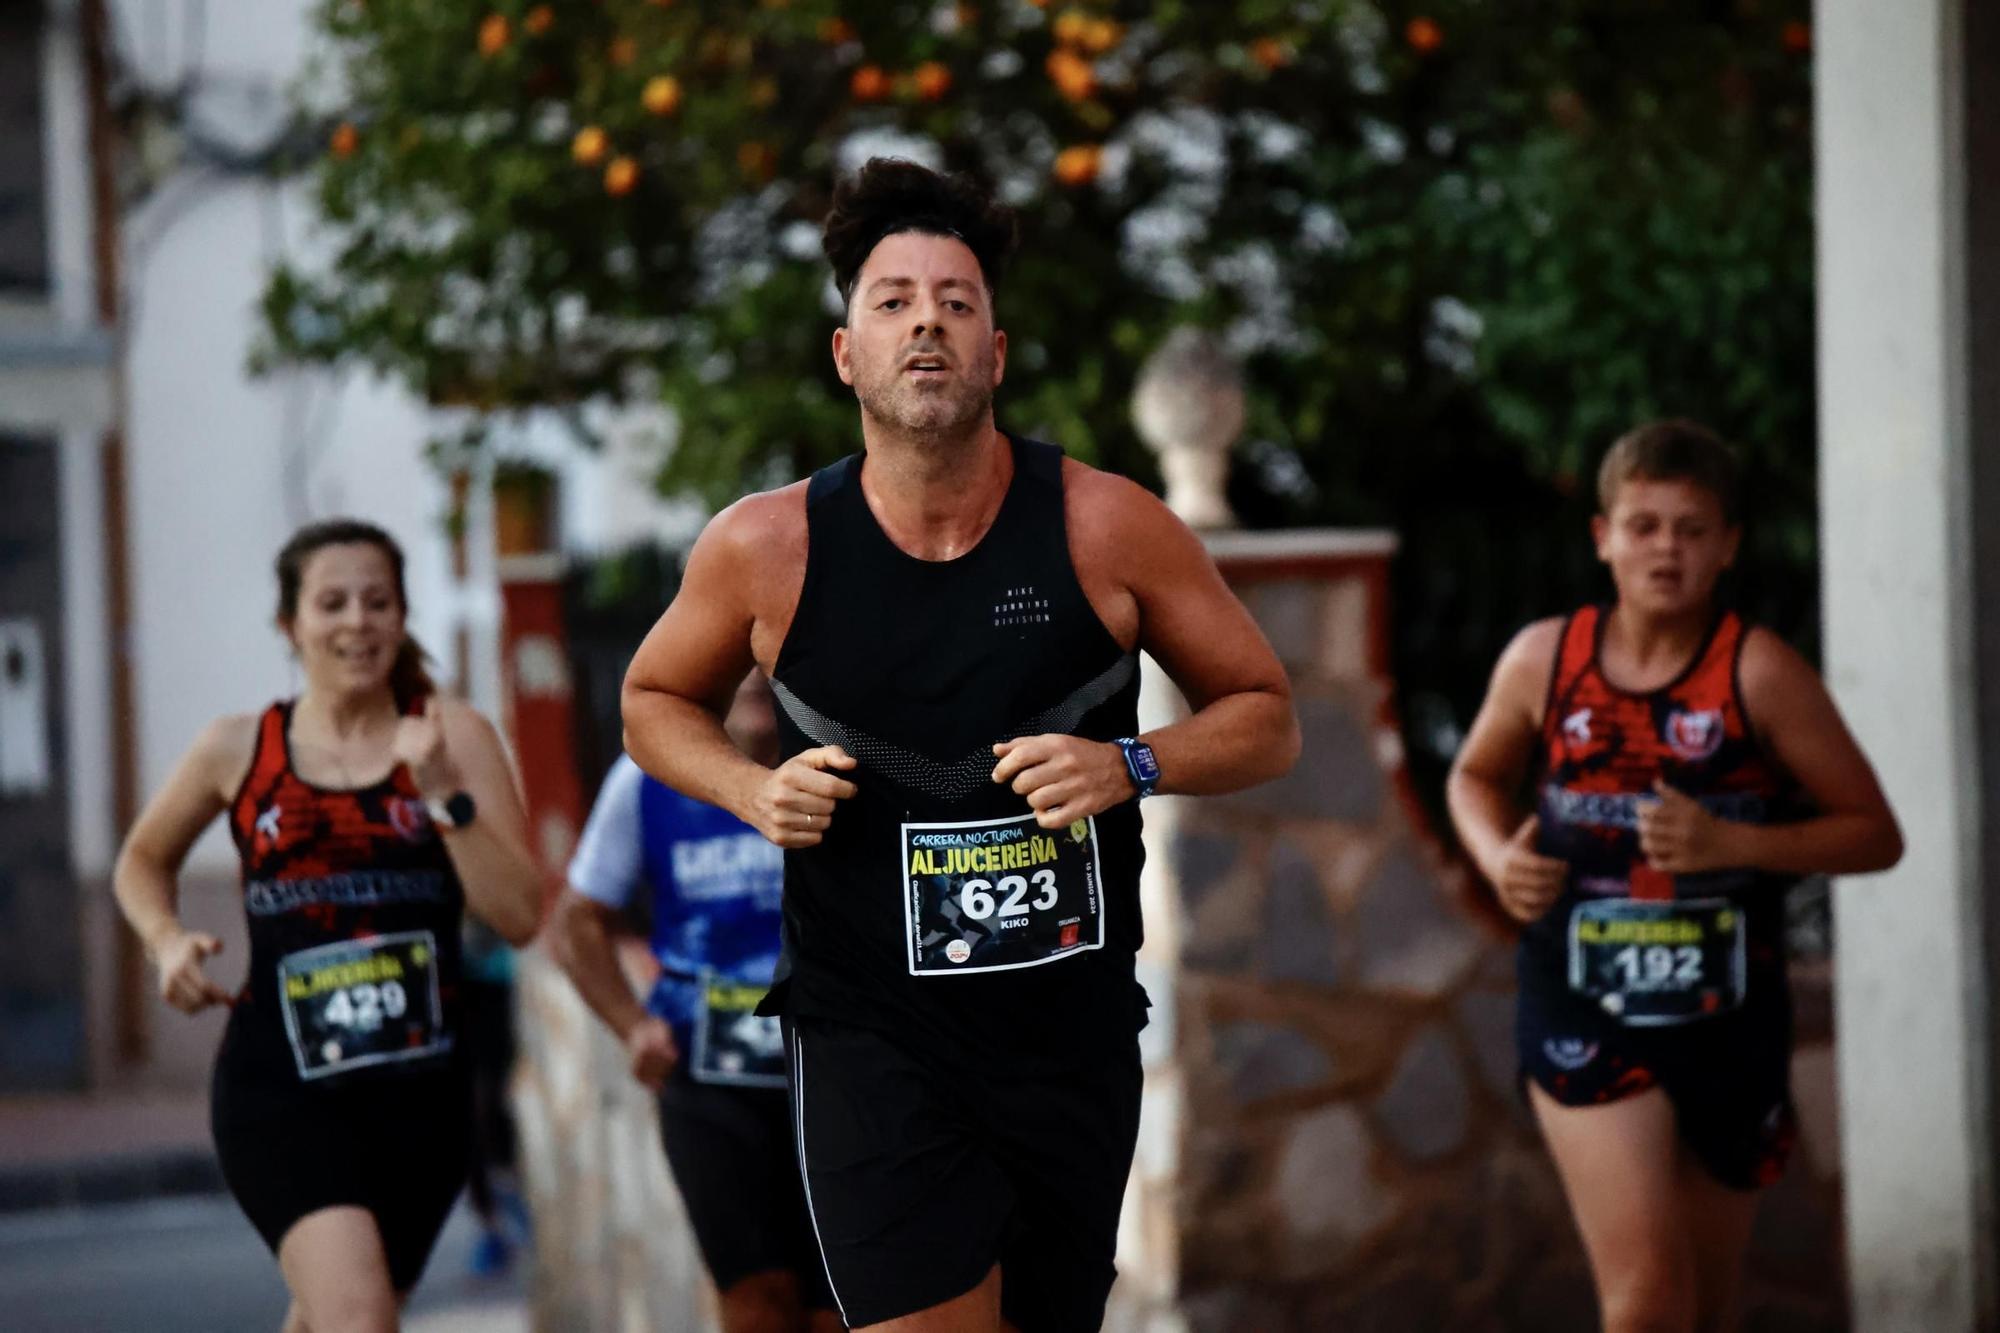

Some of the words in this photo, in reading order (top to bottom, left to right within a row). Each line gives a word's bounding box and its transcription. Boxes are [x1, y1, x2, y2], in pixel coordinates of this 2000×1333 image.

[1007, 586, 1033, 597] NIKE
[995, 600, 1049, 613] RUNNING
[994, 614, 1050, 626] DIVISION
[912, 832, 964, 847] CARRERA
[966, 827, 1024, 845] NOCTURNA
[910, 835, 1058, 875] ALJUCEREÑA
[1086, 872, 1095, 895] JUNIO
[961, 869, 1059, 920] 623
[1001, 917, 1030, 930] KIKO
[1614, 945, 1704, 982] 192
[324, 979, 407, 1030] 429
